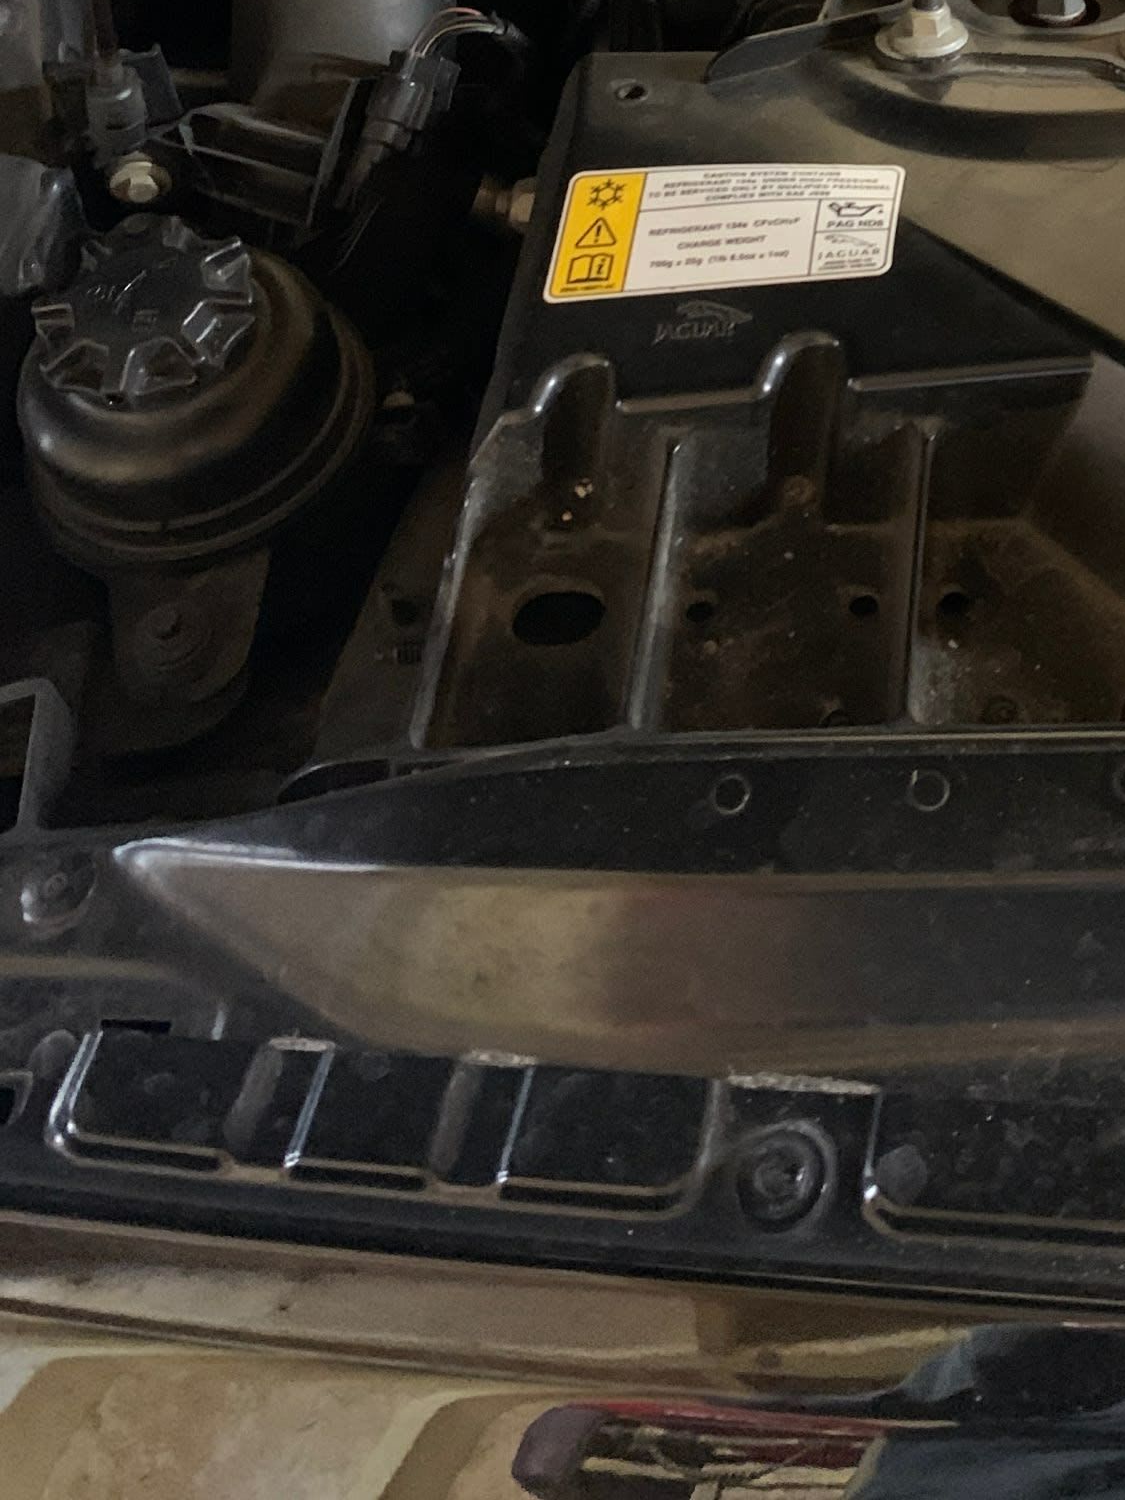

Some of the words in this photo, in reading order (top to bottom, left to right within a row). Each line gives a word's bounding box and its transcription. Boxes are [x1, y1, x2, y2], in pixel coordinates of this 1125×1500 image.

[664, 179, 732, 189] REFRIGERANT
[680, 187, 728, 196] SERVICED
[705, 192, 755, 201] COMPLIES
[827, 220, 854, 228] PAG
[648, 223, 722, 236] REFRIGERANT
[677, 239, 721, 250] CHARGE
[725, 235, 767, 245] WEIGHT
[817, 247, 881, 261] JAGUAR
